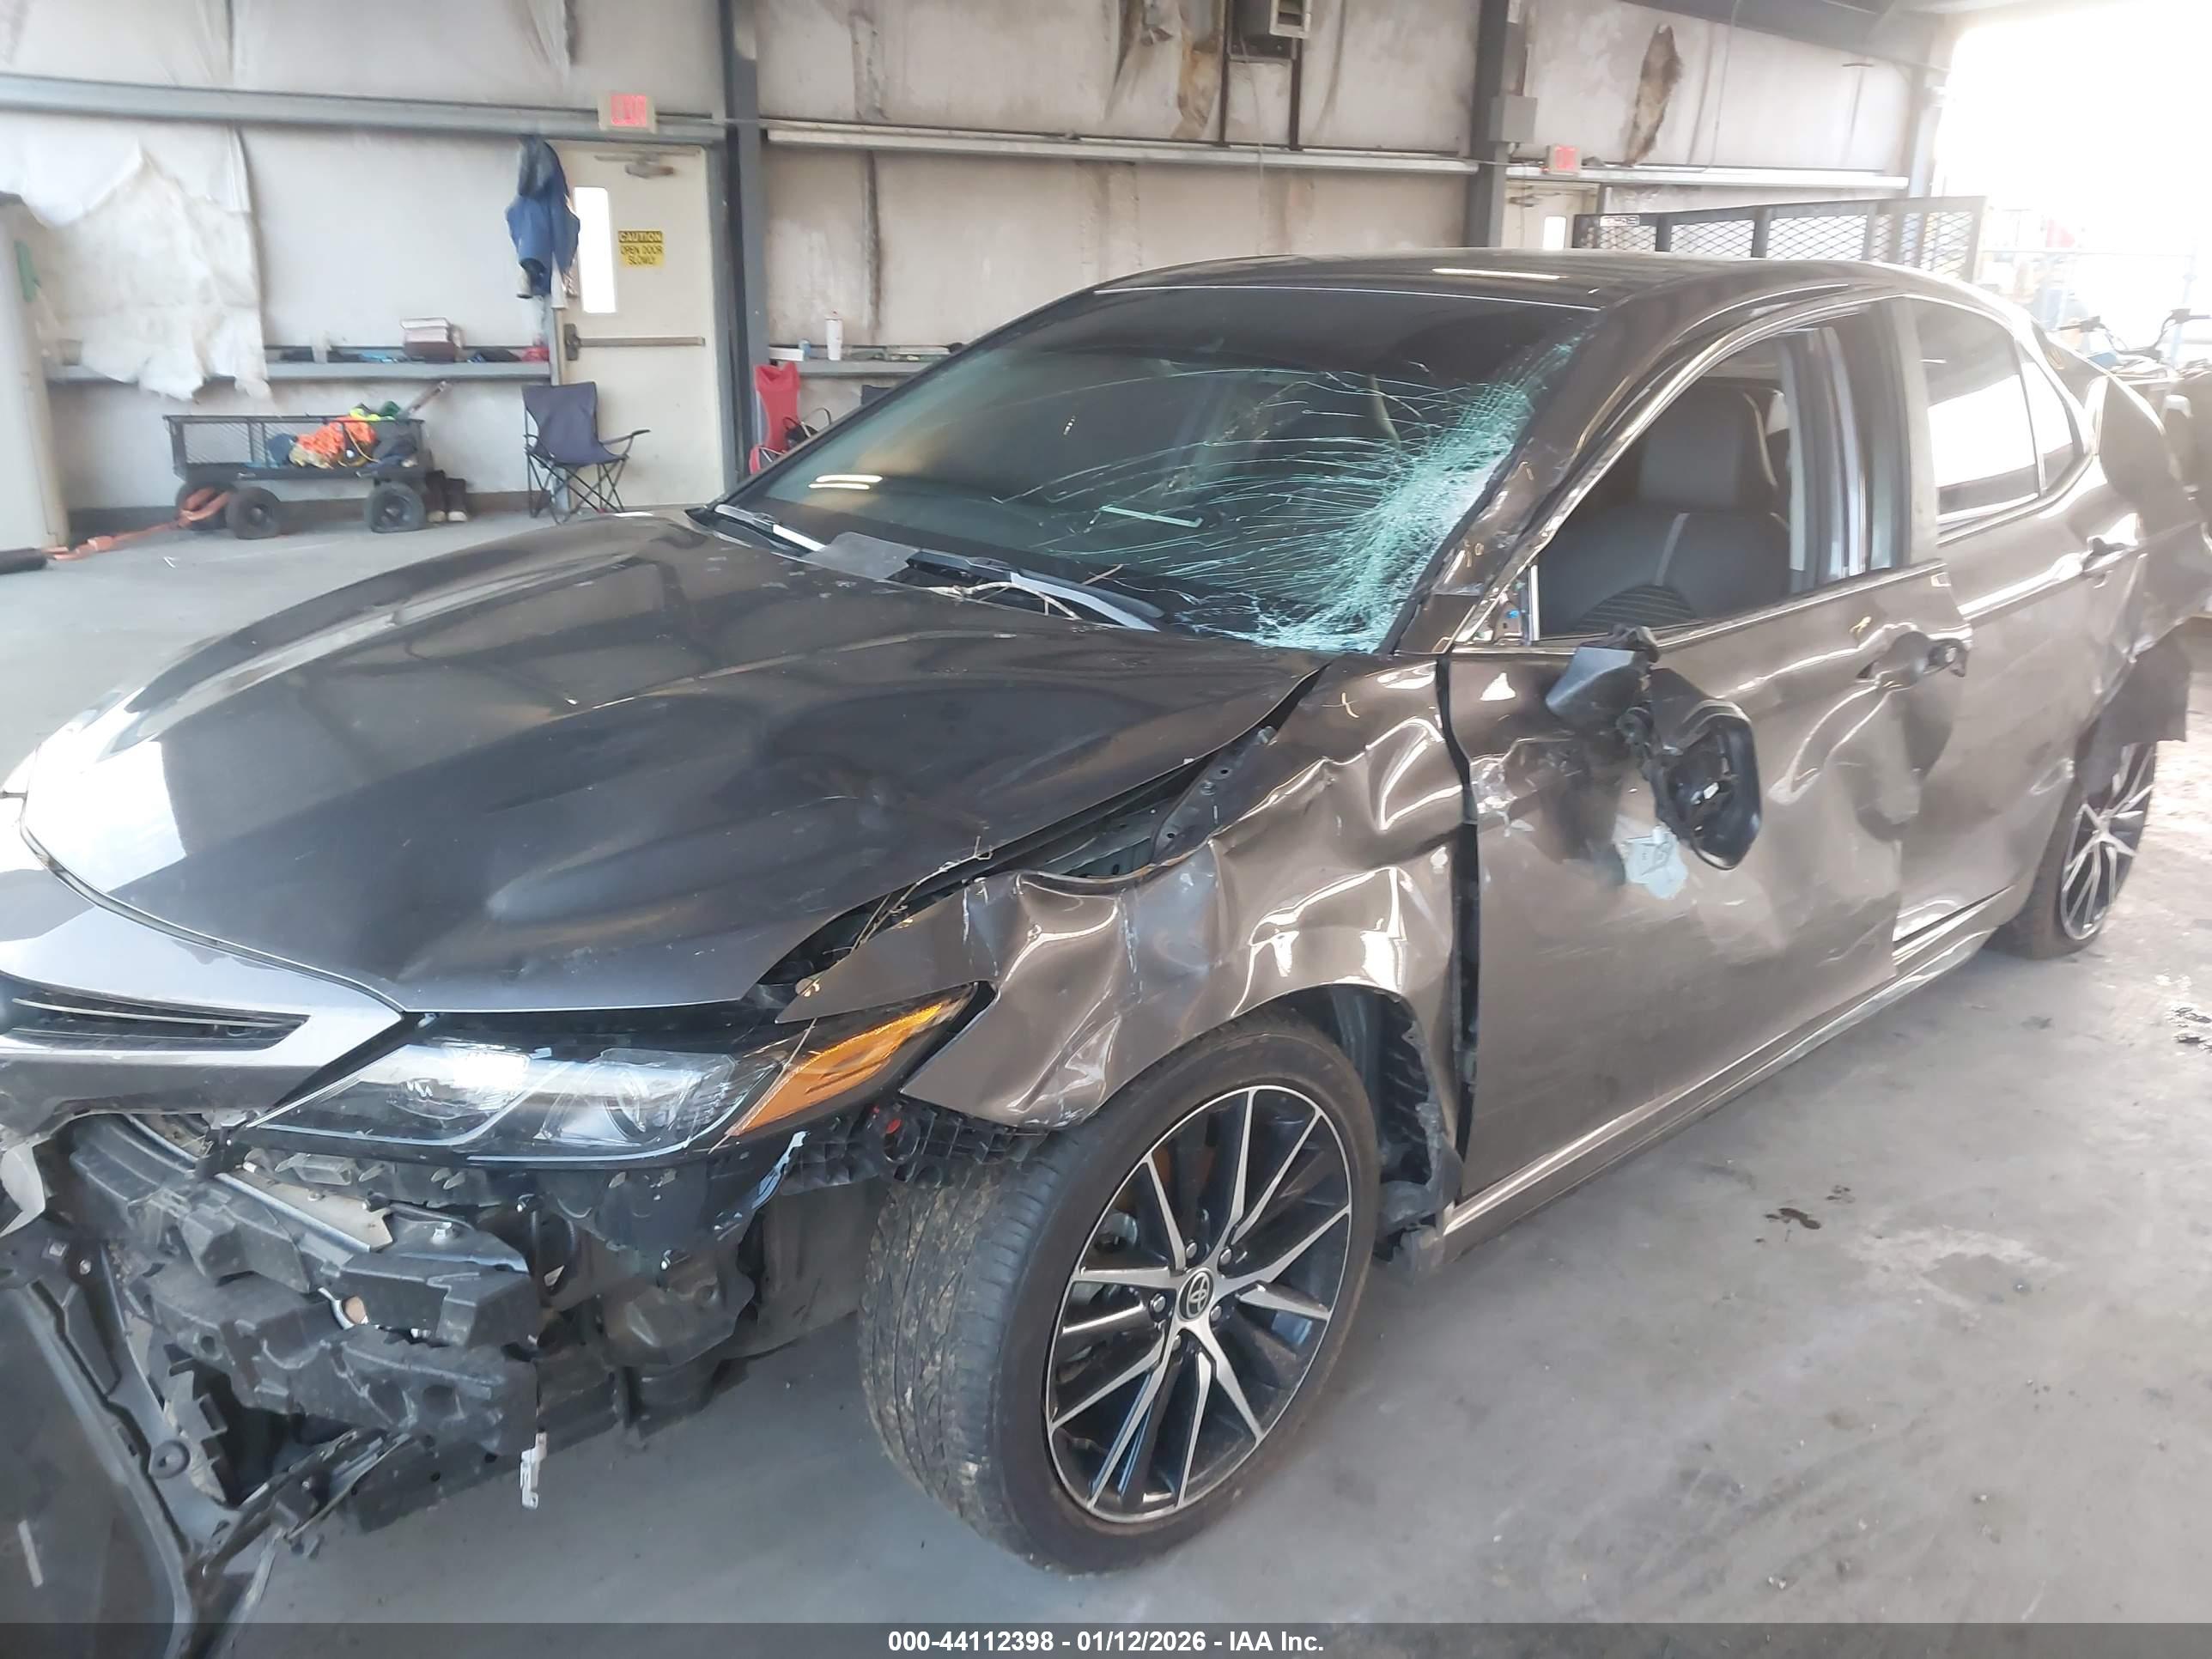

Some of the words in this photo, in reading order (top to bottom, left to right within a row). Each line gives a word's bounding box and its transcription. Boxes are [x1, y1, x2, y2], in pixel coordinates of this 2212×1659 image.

[619, 231, 661, 242] CAUTION
[620, 245, 640, 255] OPEN
[642, 245, 663, 255] DOOR
